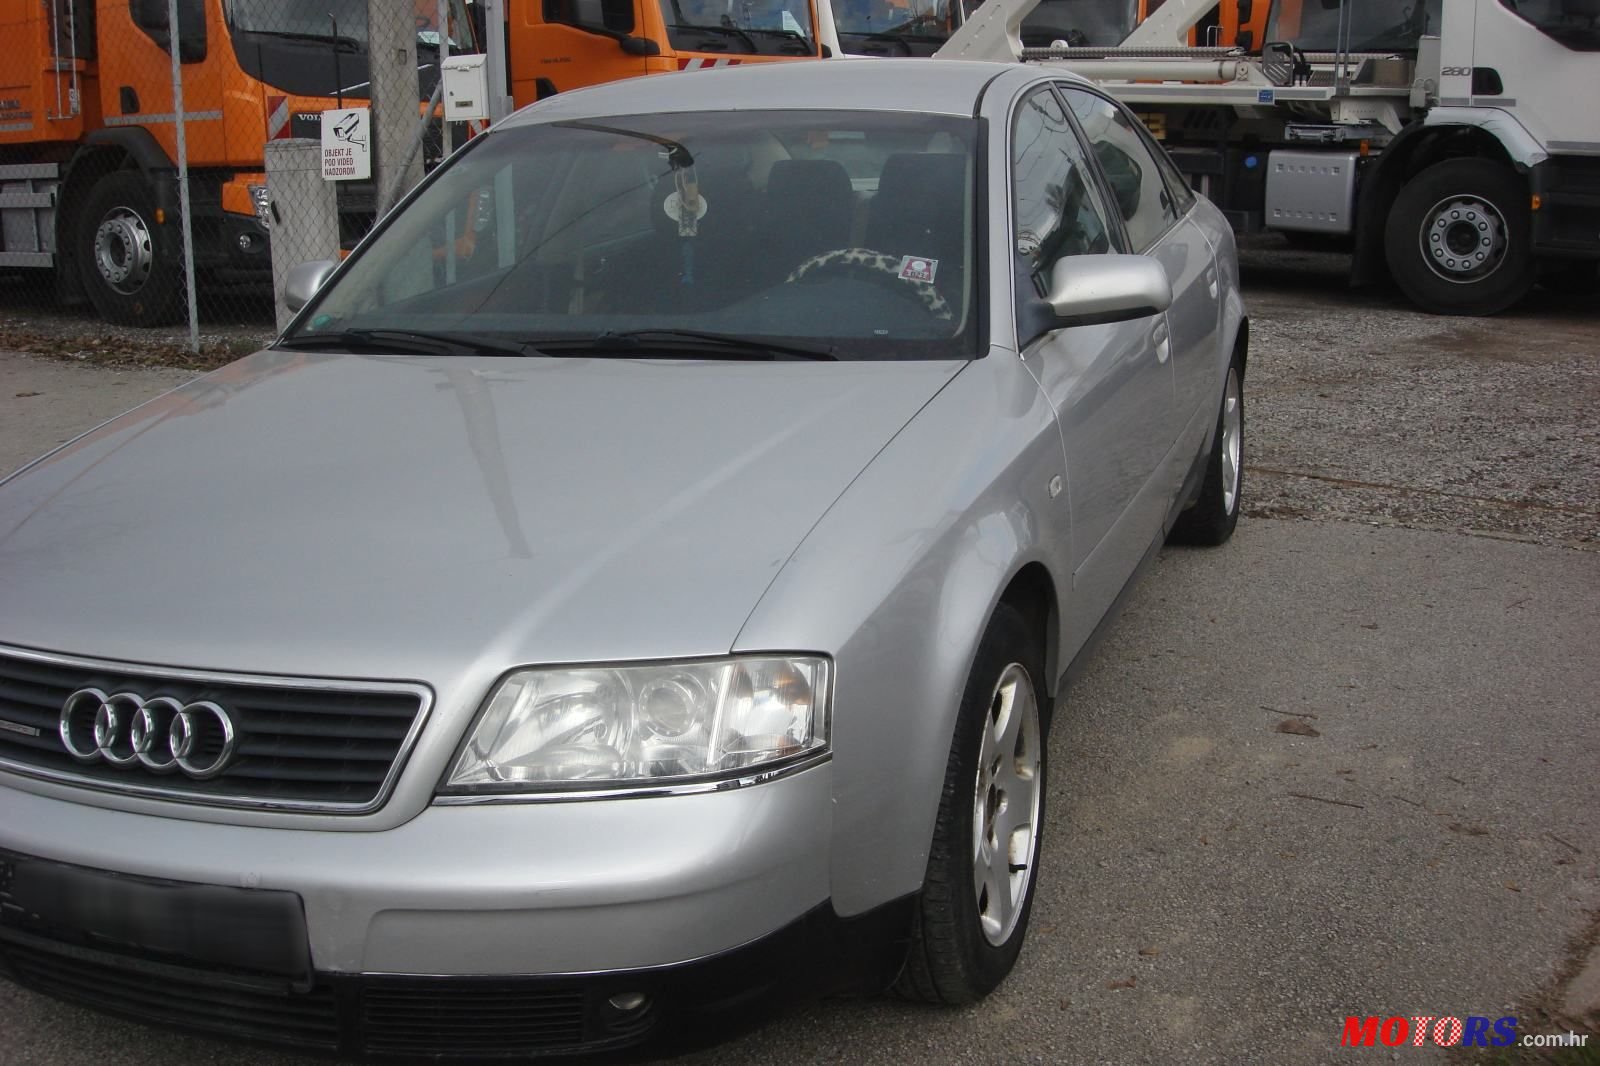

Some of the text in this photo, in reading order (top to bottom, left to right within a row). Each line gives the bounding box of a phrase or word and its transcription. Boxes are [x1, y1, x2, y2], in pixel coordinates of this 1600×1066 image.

[324, 148, 352, 157] OBJEKT JE
[324, 157, 353, 166] POD VIDEO
[324, 167, 355, 176] NADZOROM
